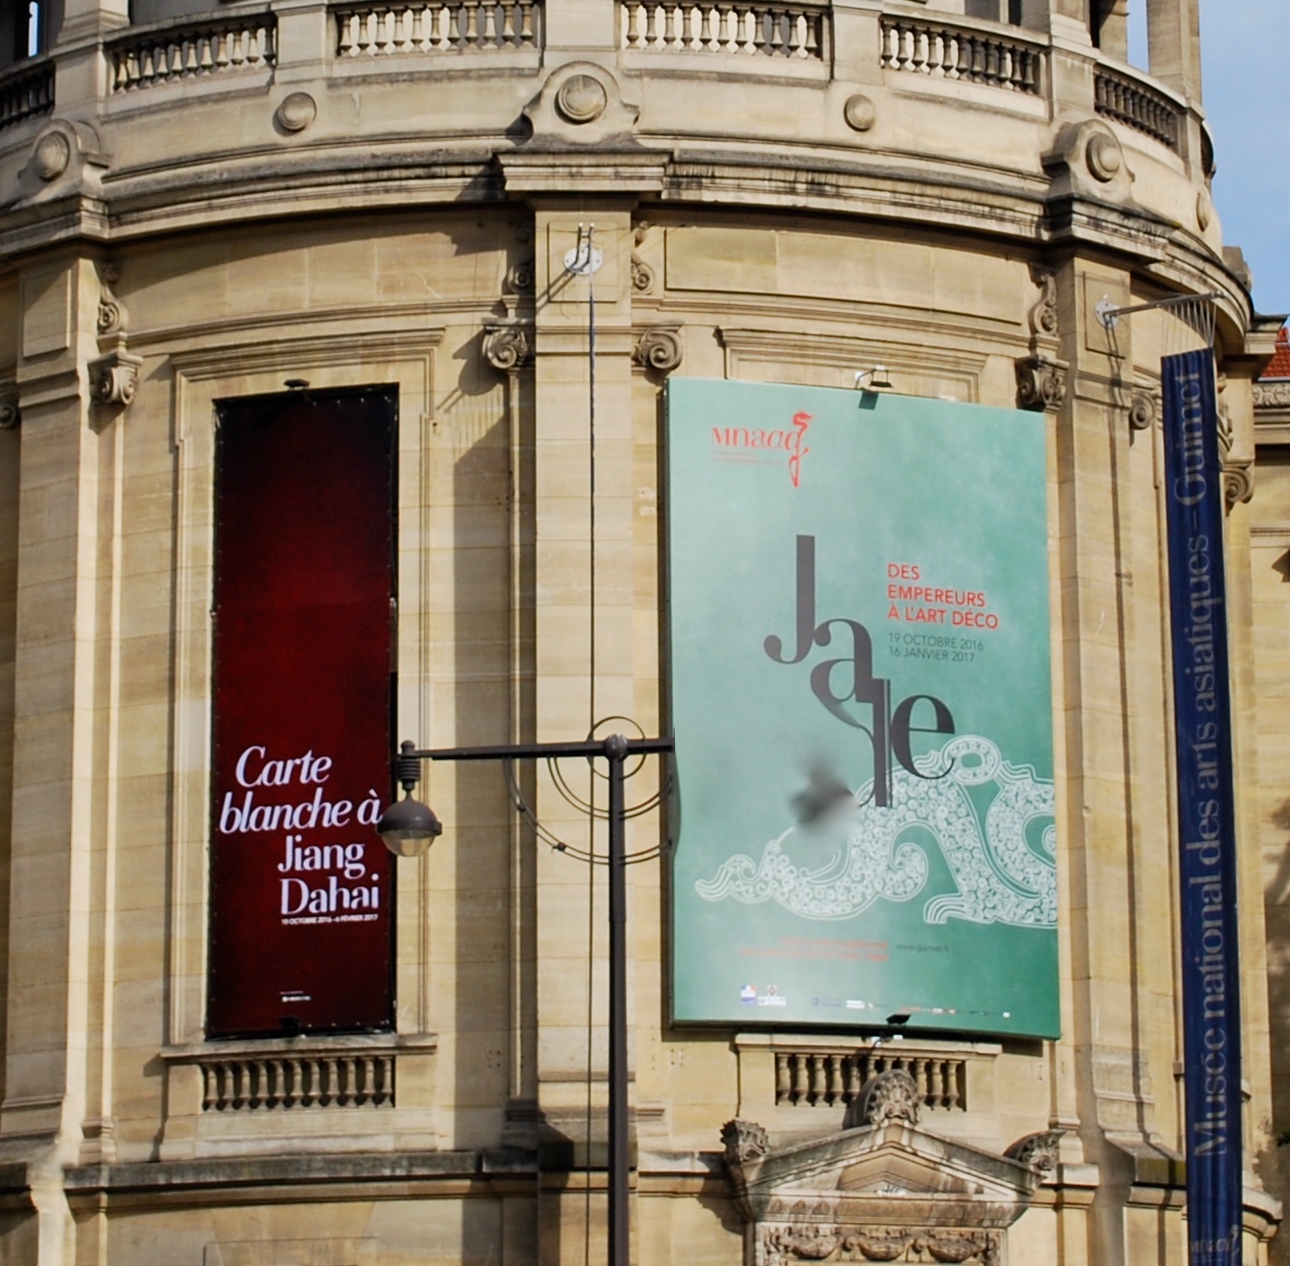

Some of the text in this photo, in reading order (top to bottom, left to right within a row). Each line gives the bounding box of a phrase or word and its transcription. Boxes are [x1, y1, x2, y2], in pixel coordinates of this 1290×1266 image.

[1174, 373, 1207, 506] Guimet
[887, 563, 920, 581] DES
[887, 584, 986, 608] EMPEREURS
[887, 601, 999, 630] À L'ART DÉCO
[889, 632, 984, 651] 19 OCTOBRE 2016
[1184, 533, 1223, 712] asiatiques
[763, 534, 956, 808] Jade
[889, 646, 975, 663] 16 JANVIER 2017
[235, 745, 333, 788] Carte
[1192, 721, 1219, 789] arts
[219, 787, 384, 834] blanche à
[1185, 799, 1221, 866] des
[277, 835, 366, 880] Jiang
[279, 873, 379, 915] Dahai
[1188, 871, 1225, 1019] national
[1193, 1028, 1228, 1156] Musée
